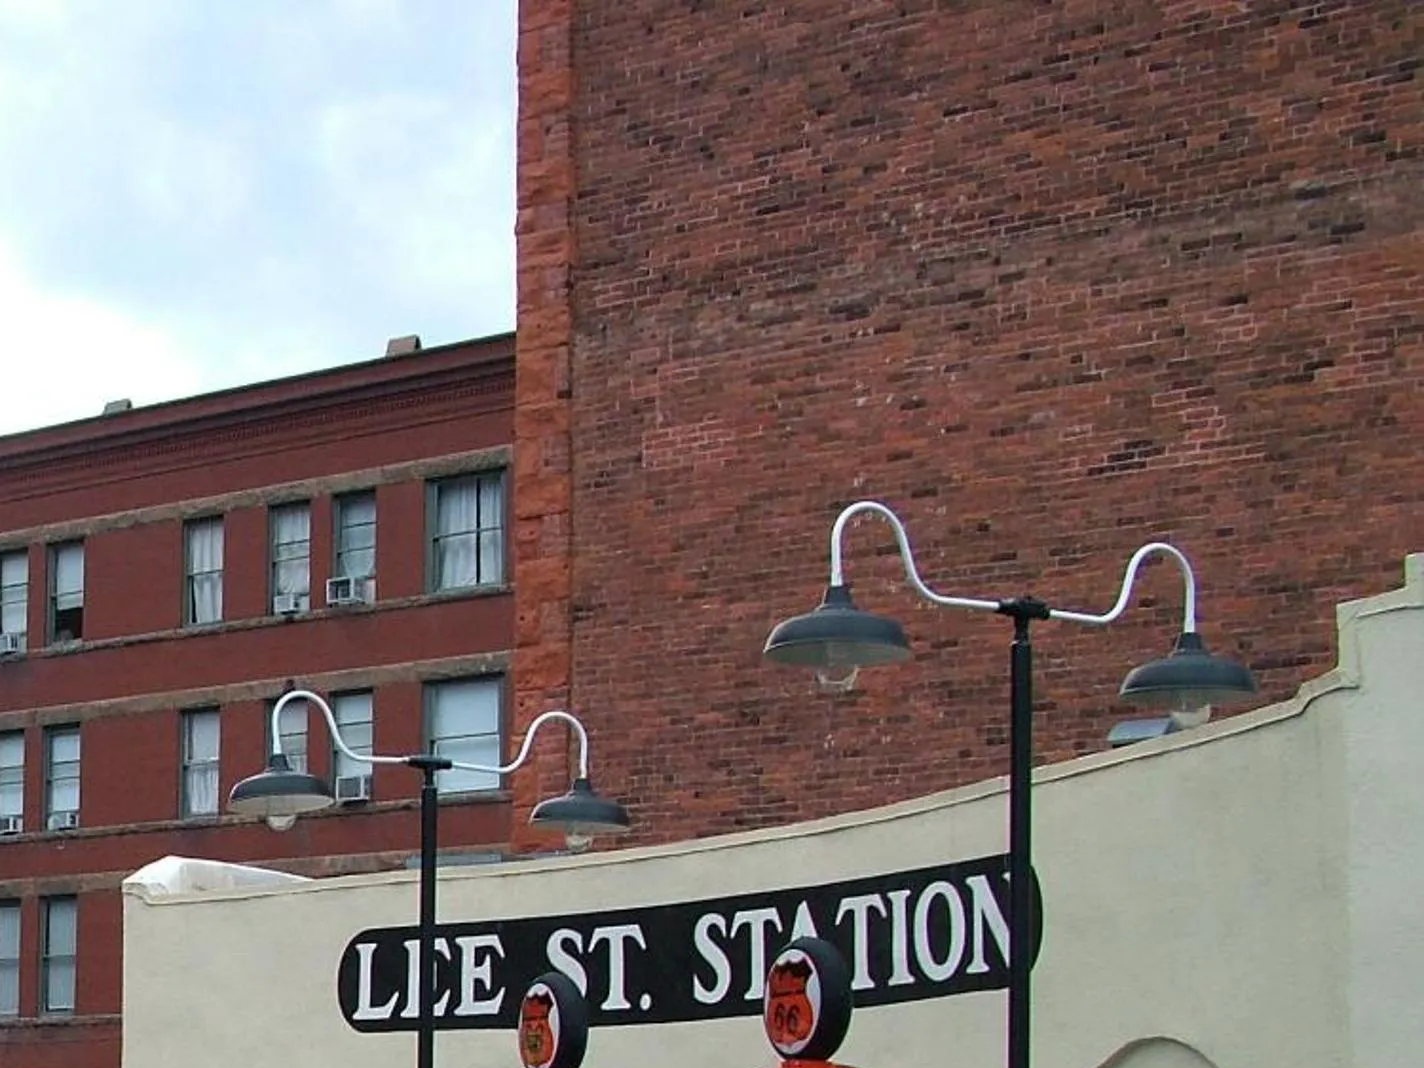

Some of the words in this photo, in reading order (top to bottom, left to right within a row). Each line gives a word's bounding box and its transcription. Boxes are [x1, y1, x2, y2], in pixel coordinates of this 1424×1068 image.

[352, 933, 506, 1021] LEE
[545, 923, 653, 1012] ST.
[774, 1003, 801, 1035] 66
